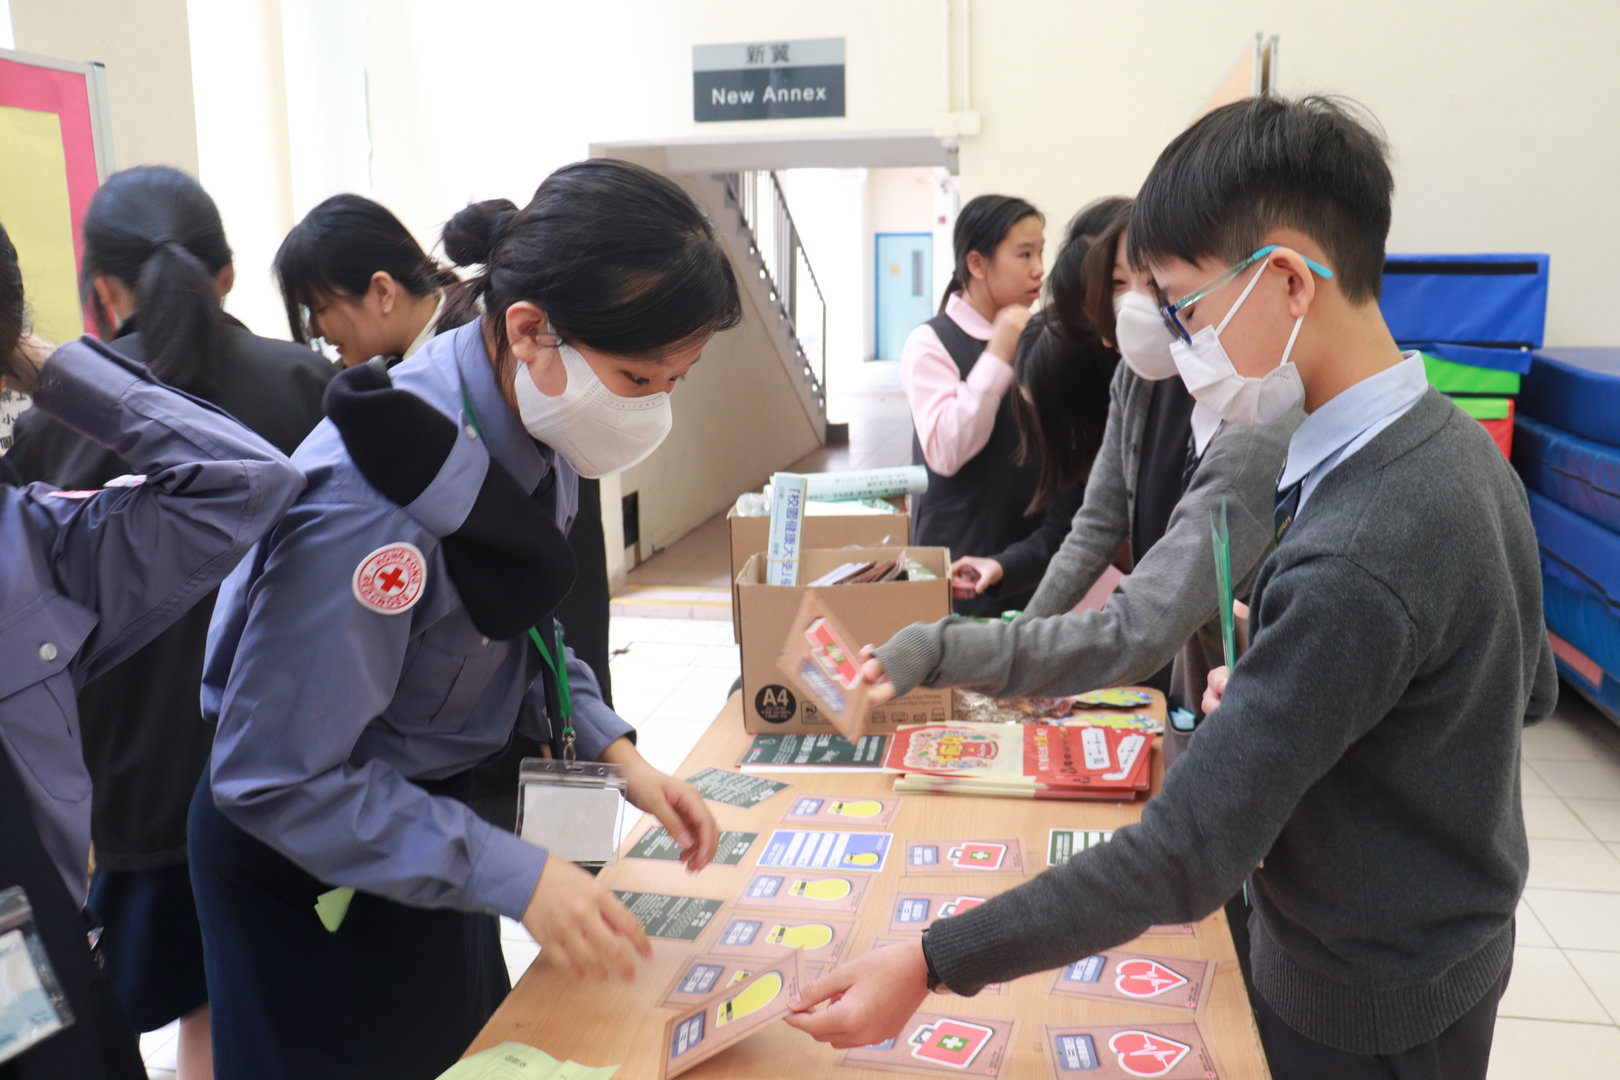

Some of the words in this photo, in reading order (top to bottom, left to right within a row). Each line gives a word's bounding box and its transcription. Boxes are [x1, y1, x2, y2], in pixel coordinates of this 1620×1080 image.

[746, 43, 790, 64] 新翼
[711, 87, 755, 106] New
[762, 86, 827, 103] Annex
[762, 687, 789, 707] A4
